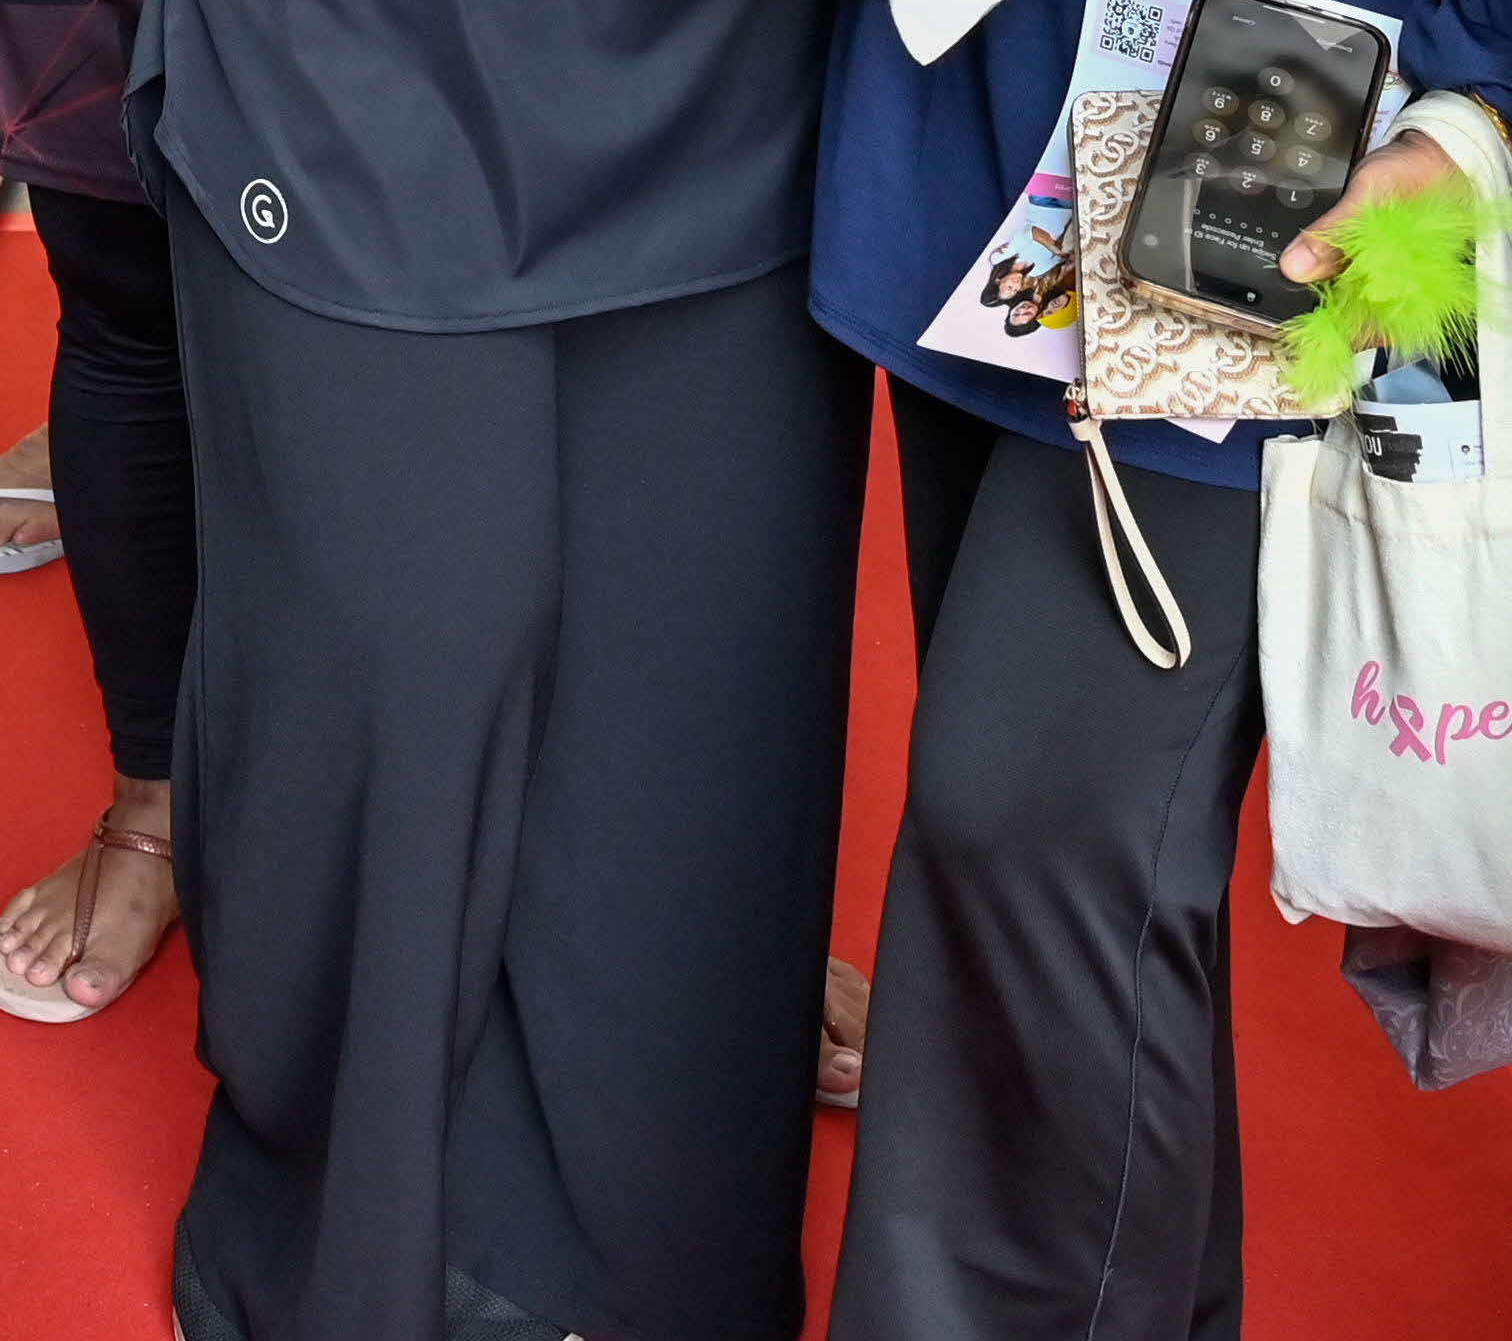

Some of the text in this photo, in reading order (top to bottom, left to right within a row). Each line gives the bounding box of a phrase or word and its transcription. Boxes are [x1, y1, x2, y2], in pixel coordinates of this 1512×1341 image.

[1270, 75, 1281, 87] 0
[1260, 110, 1272, 123] 8
[1305, 124, 1317, 136] 7
[1251, 143, 1263, 156] 5
[1297, 156, 1309, 168] 4
[1194, 163, 1206, 175] 3
[1241, 177, 1253, 190] 2
